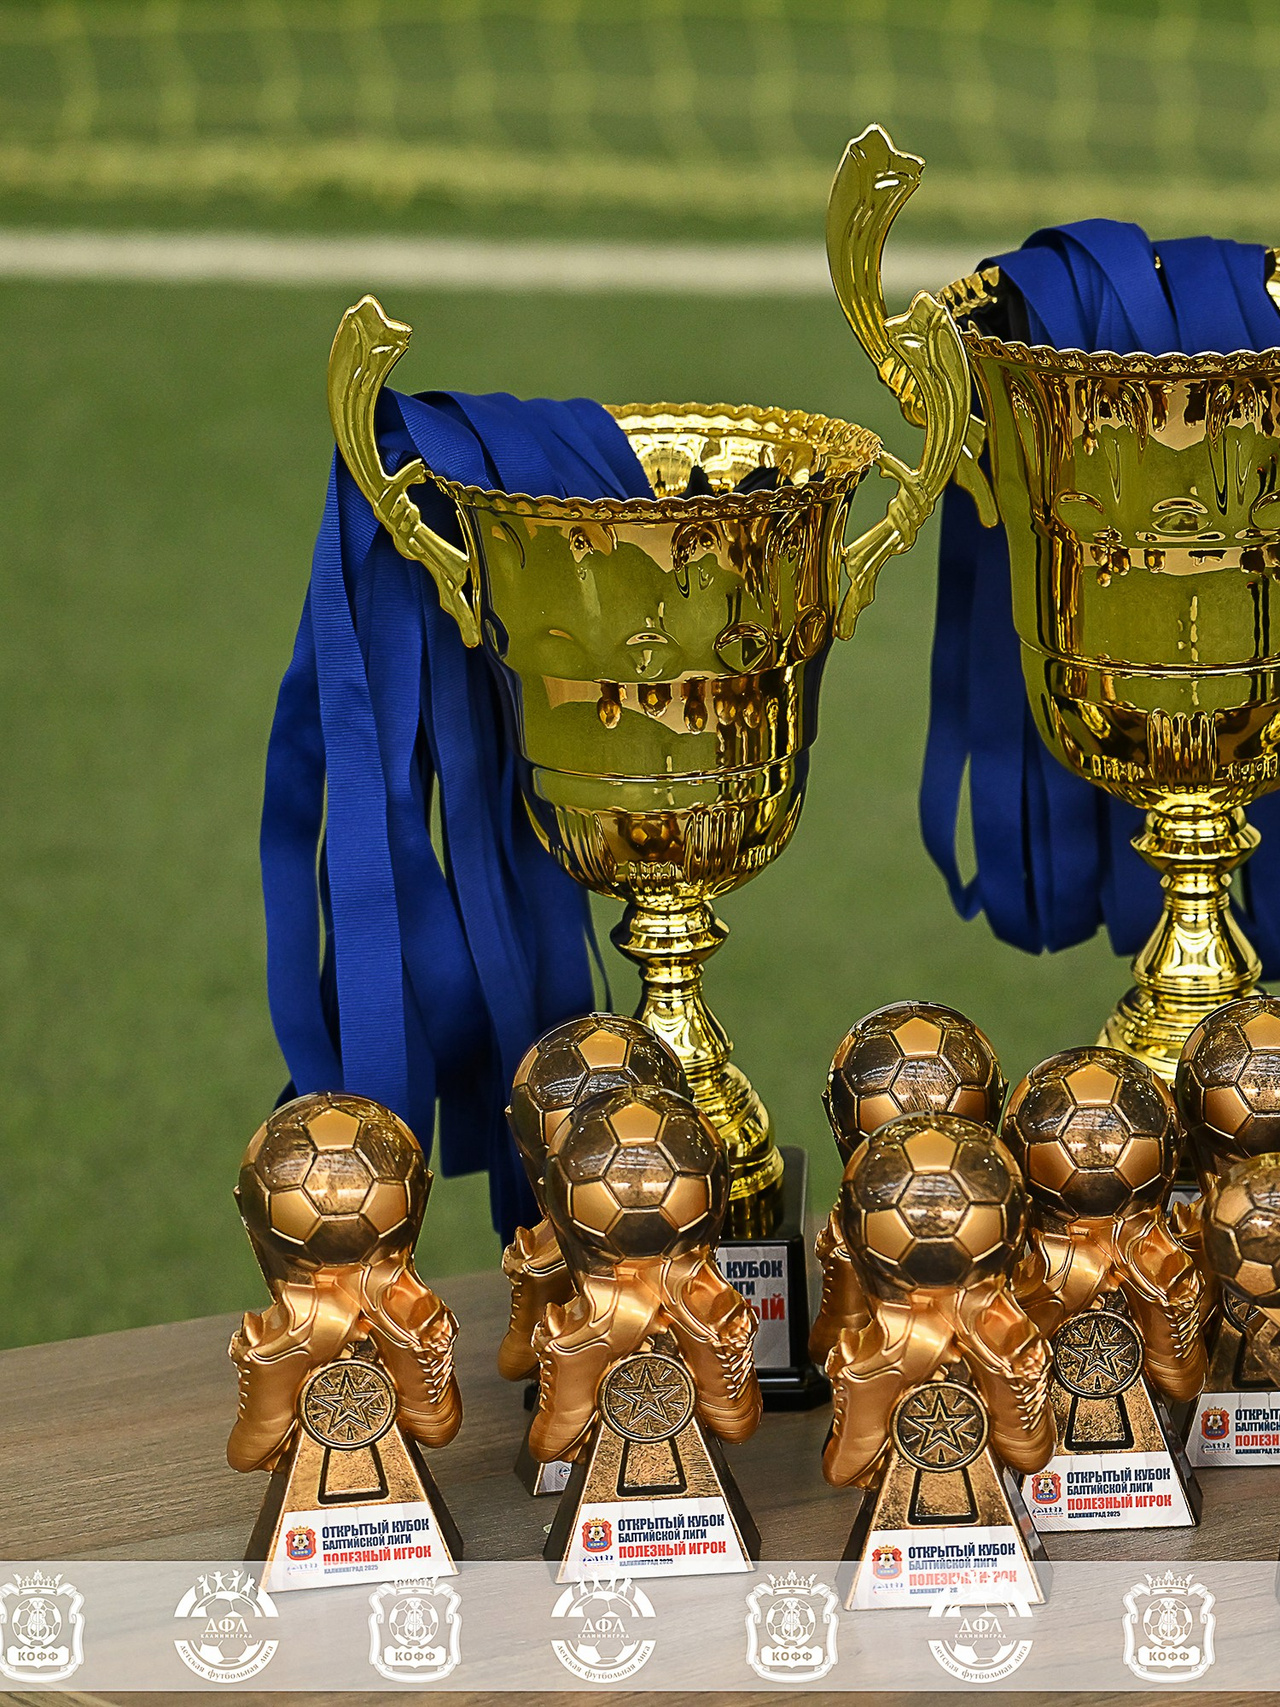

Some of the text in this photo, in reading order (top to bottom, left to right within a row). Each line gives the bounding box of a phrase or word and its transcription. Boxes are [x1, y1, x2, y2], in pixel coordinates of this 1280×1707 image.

[726, 1260, 782, 1278] КУБОК
[1067, 1467, 1170, 1484] ОТКРЫТЫЙ КУБОК
[1067, 1482, 1153, 1496] БАЛТИЙСКОЙ ЛИГИ
[1068, 1494, 1172, 1511] ПОЛЕЗНЫЙ ИГРОК
[322, 1518, 429, 1538] ОТКРЫТЫЙ КУБОК
[618, 1514, 724, 1531] ОТКРЫТЫЙ КУБОК
[323, 1534, 411, 1550] БАЛТИЙСКОЙ ЛИГИ
[618, 1528, 706, 1543] БАЛТИЙСКОЙ ЛИГИ
[324, 1545, 431, 1566] ПОЛЕЗНЫЙ ИГРОК
[619, 1541, 726, 1558] ПОЛЕЗНЫЙ ИГРОК
[909, 1542, 1015, 1559] ОТКРЫТЫЙ КУБОК
[365, 1564, 378, 1572] 2025
[909, 1557, 997, 1571] БАЛТИЙСКОЙ ЛИГИ
